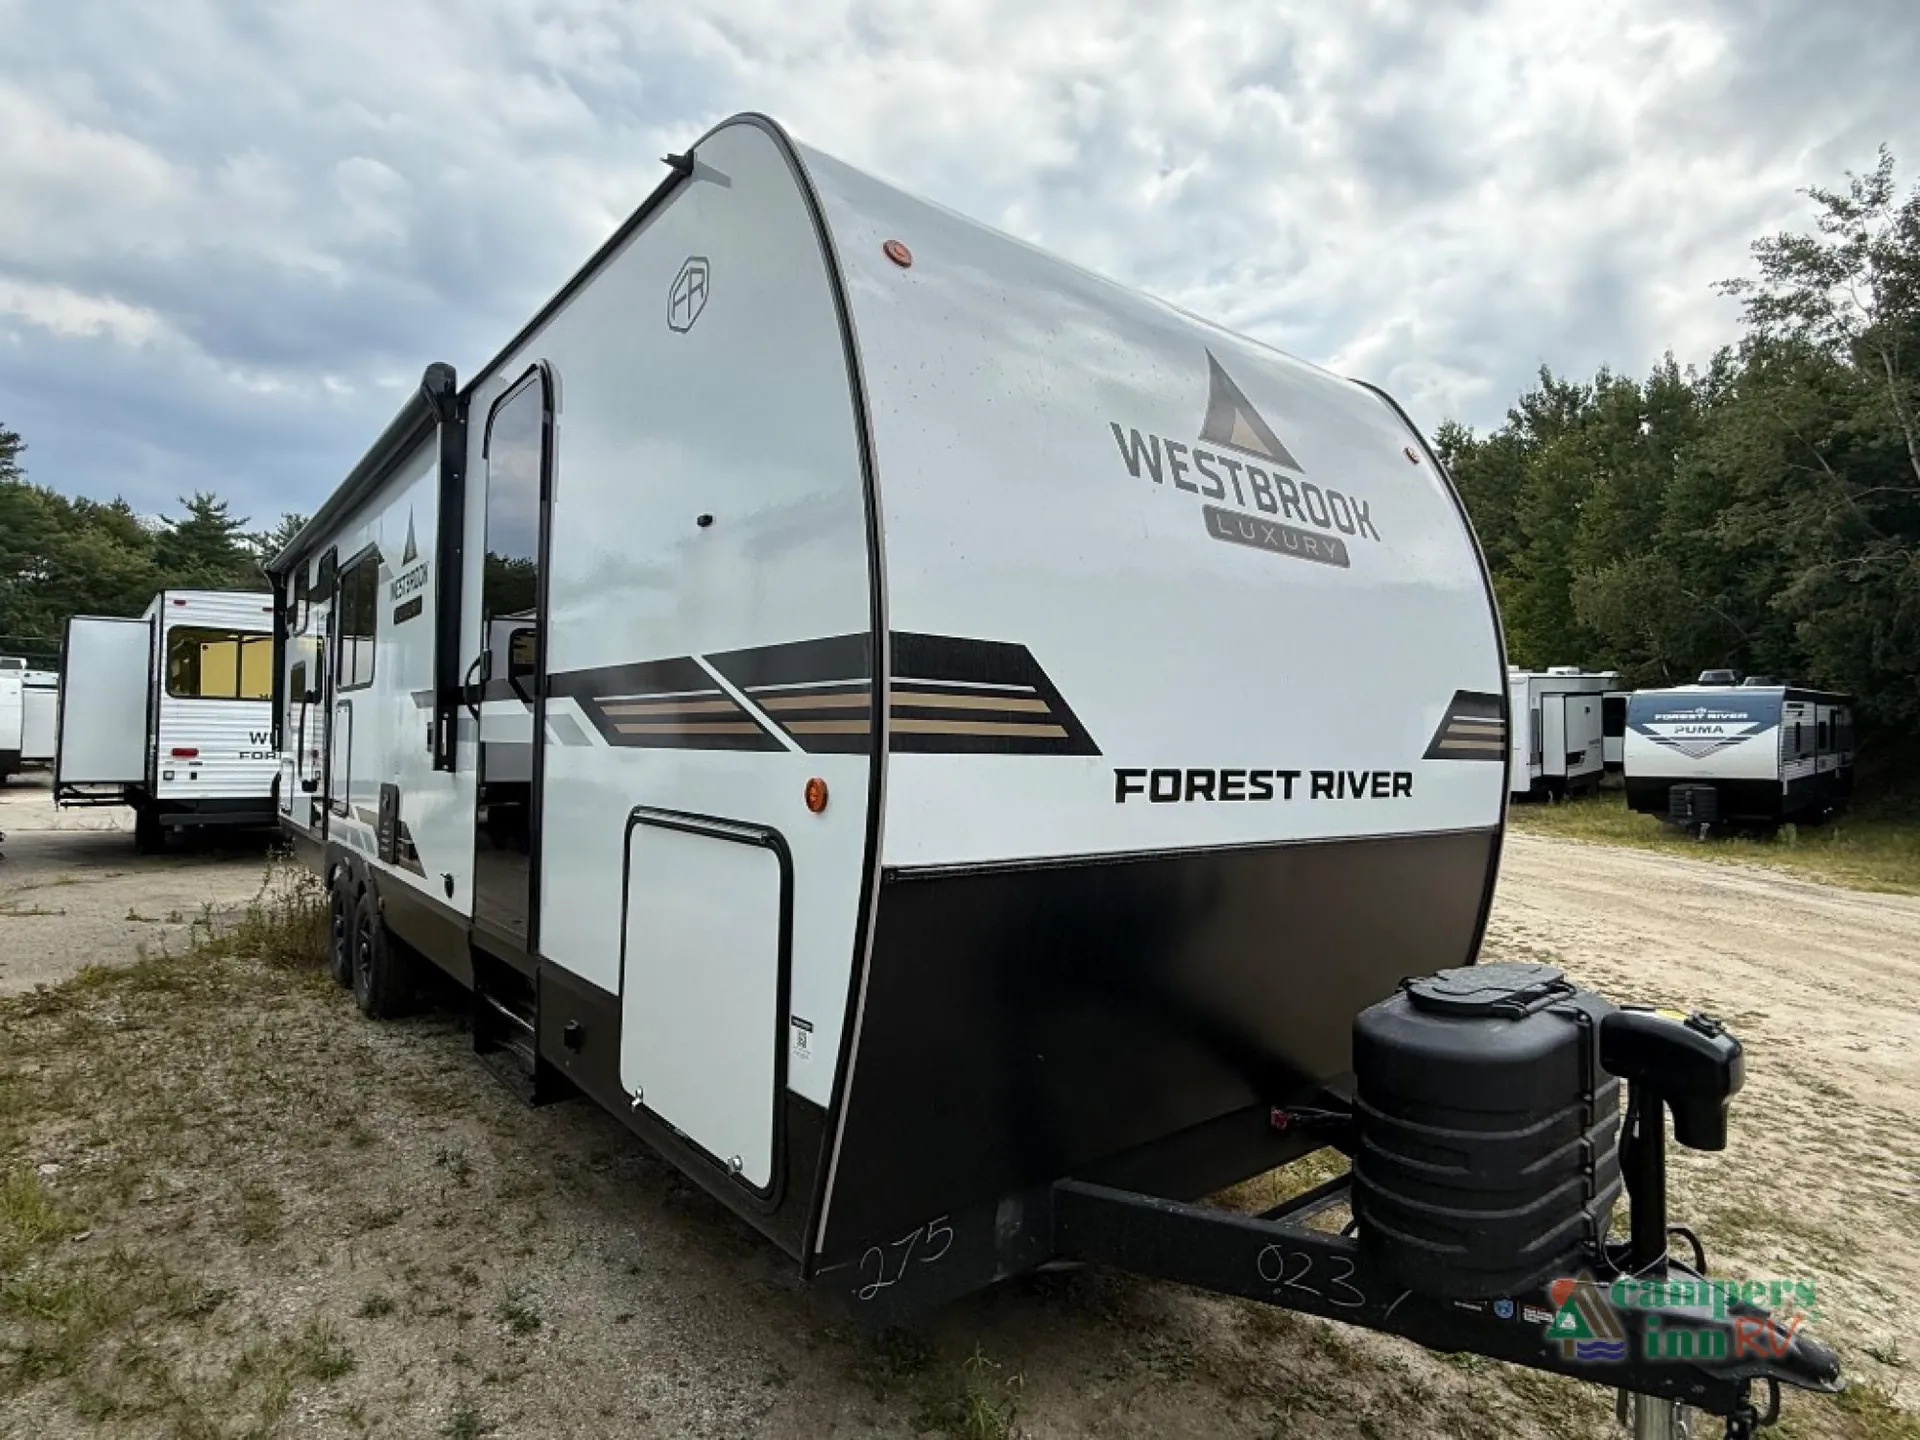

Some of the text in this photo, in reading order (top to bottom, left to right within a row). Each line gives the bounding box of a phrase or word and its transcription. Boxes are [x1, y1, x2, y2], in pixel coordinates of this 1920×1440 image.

[1109, 421, 1381, 542] WESTBROOK
[1216, 513, 1343, 559] LUXURY
[1673, 725, 1724, 734] PUMA
[1113, 768, 1413, 803] FOREST RIVER
